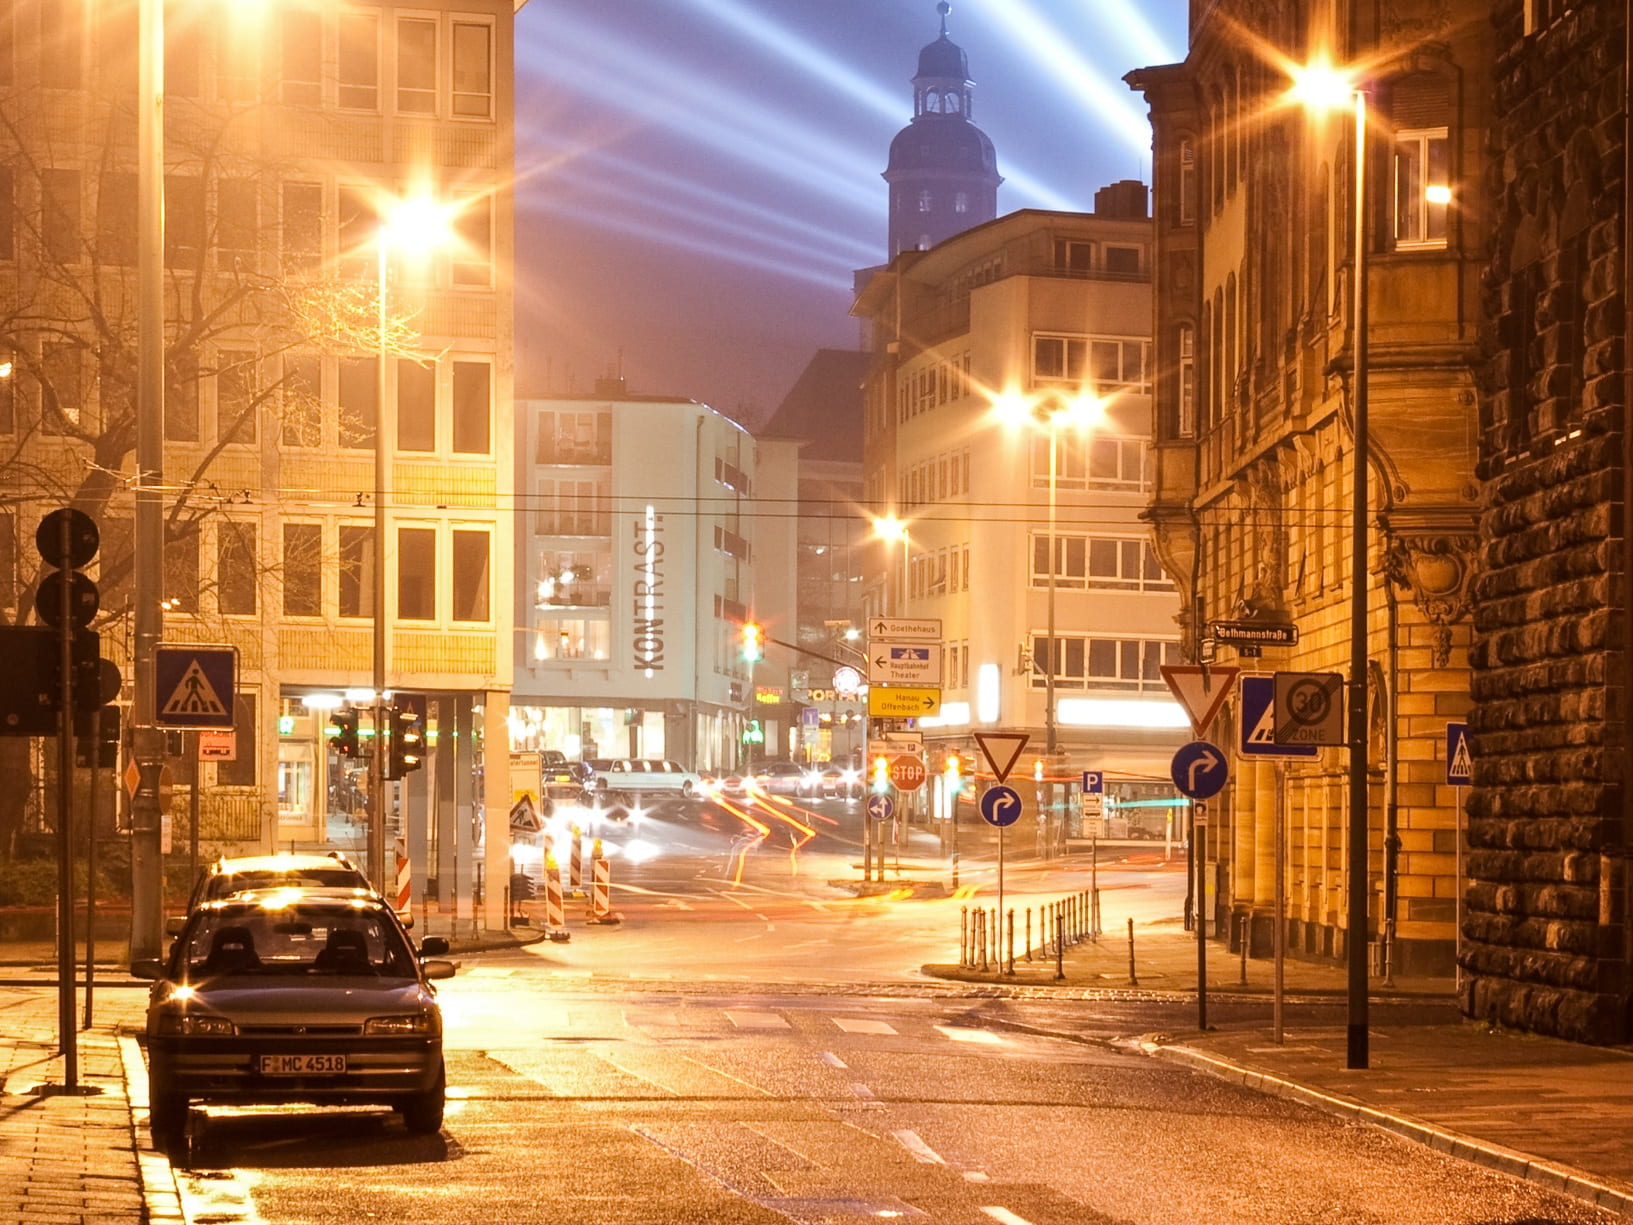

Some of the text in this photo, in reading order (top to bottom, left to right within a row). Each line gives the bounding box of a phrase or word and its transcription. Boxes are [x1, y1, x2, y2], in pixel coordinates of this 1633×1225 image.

[890, 624, 936, 633] Goethehaus
[1220, 628, 1288, 641] Bethmannstraße
[890, 662, 929, 670] Hauptbahnhof
[890, 671, 920, 679] Theater
[895, 694, 920, 702] Hanau
[1295, 691, 1321, 713] 30
[881, 702, 920, 711] Offenbach
[1292, 728, 1326, 741] ZONE
[893, 766, 922, 780] STOP
[1087, 774, 1098, 791] P
[262, 1057, 344, 1071] F MC 4518
